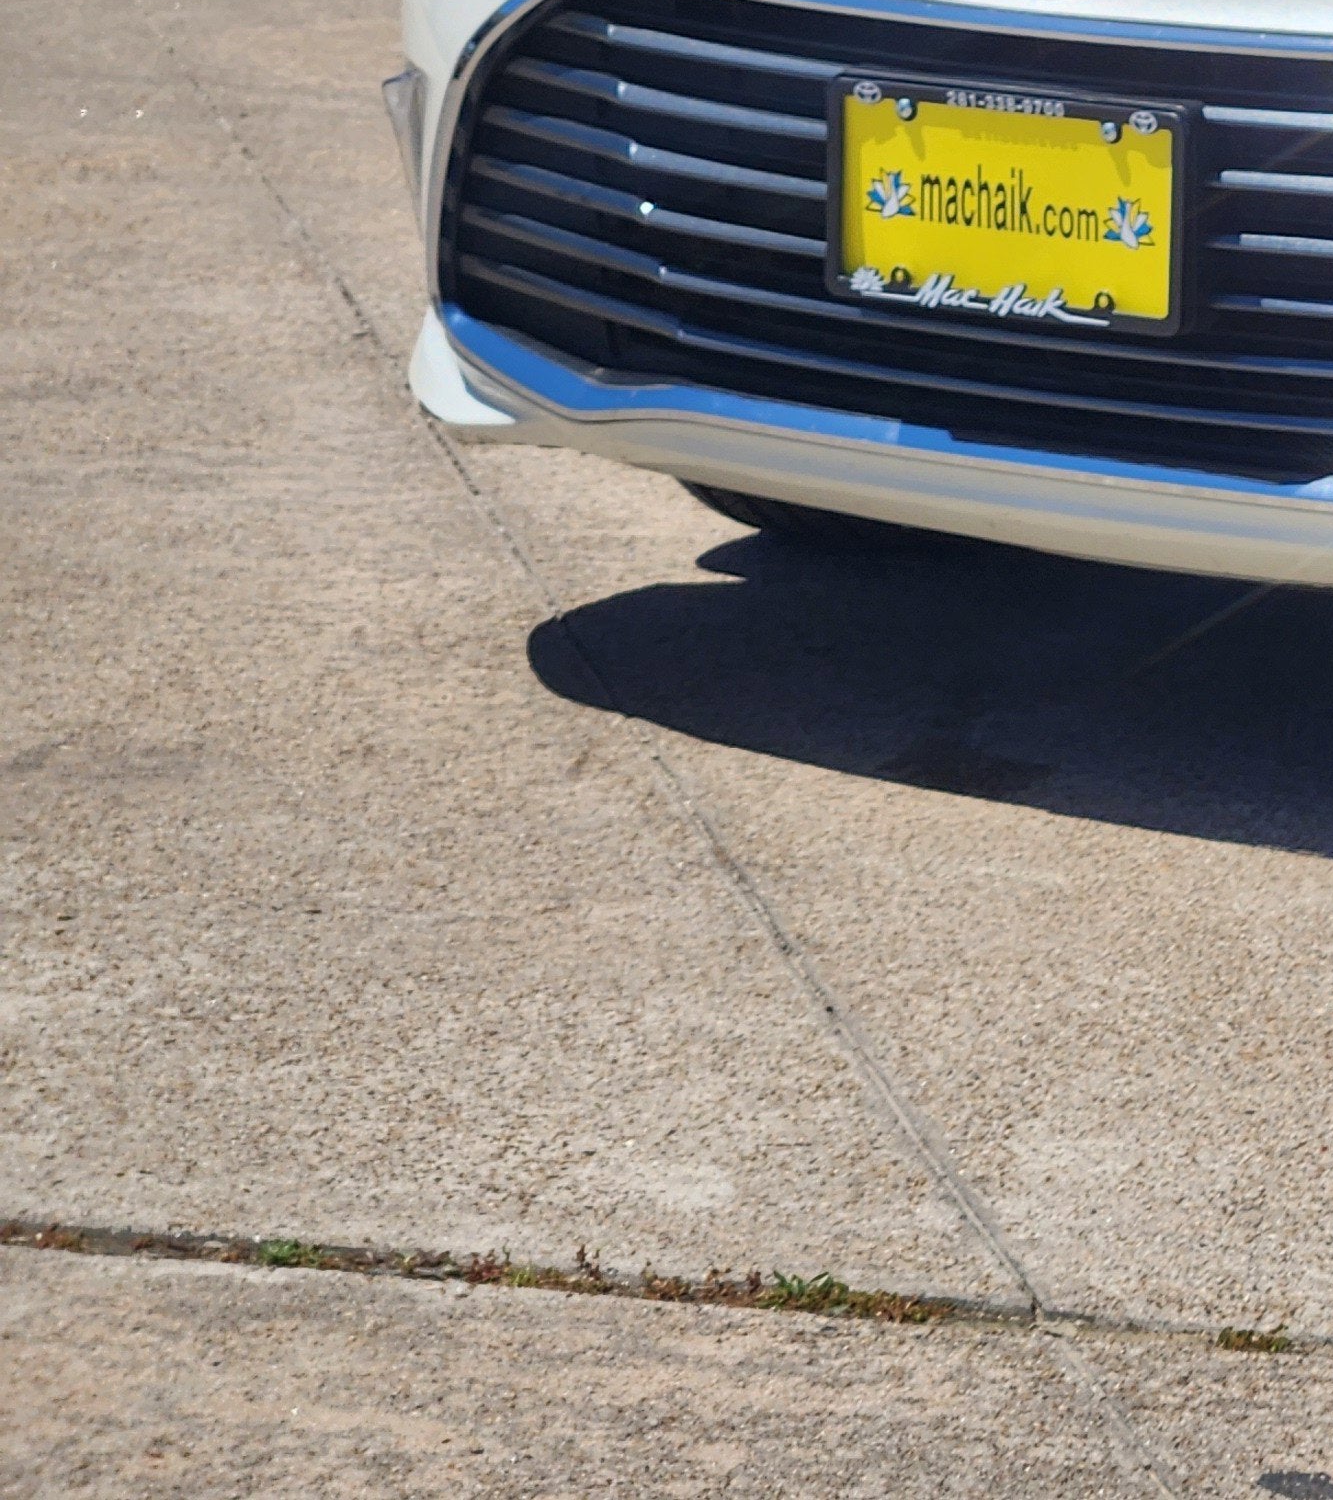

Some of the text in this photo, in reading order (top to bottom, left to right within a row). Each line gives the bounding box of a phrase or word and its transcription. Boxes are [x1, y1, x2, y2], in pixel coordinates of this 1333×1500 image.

[919, 163, 1100, 242] machaik.com
[913, 273, 1082, 324] Mac Haik
